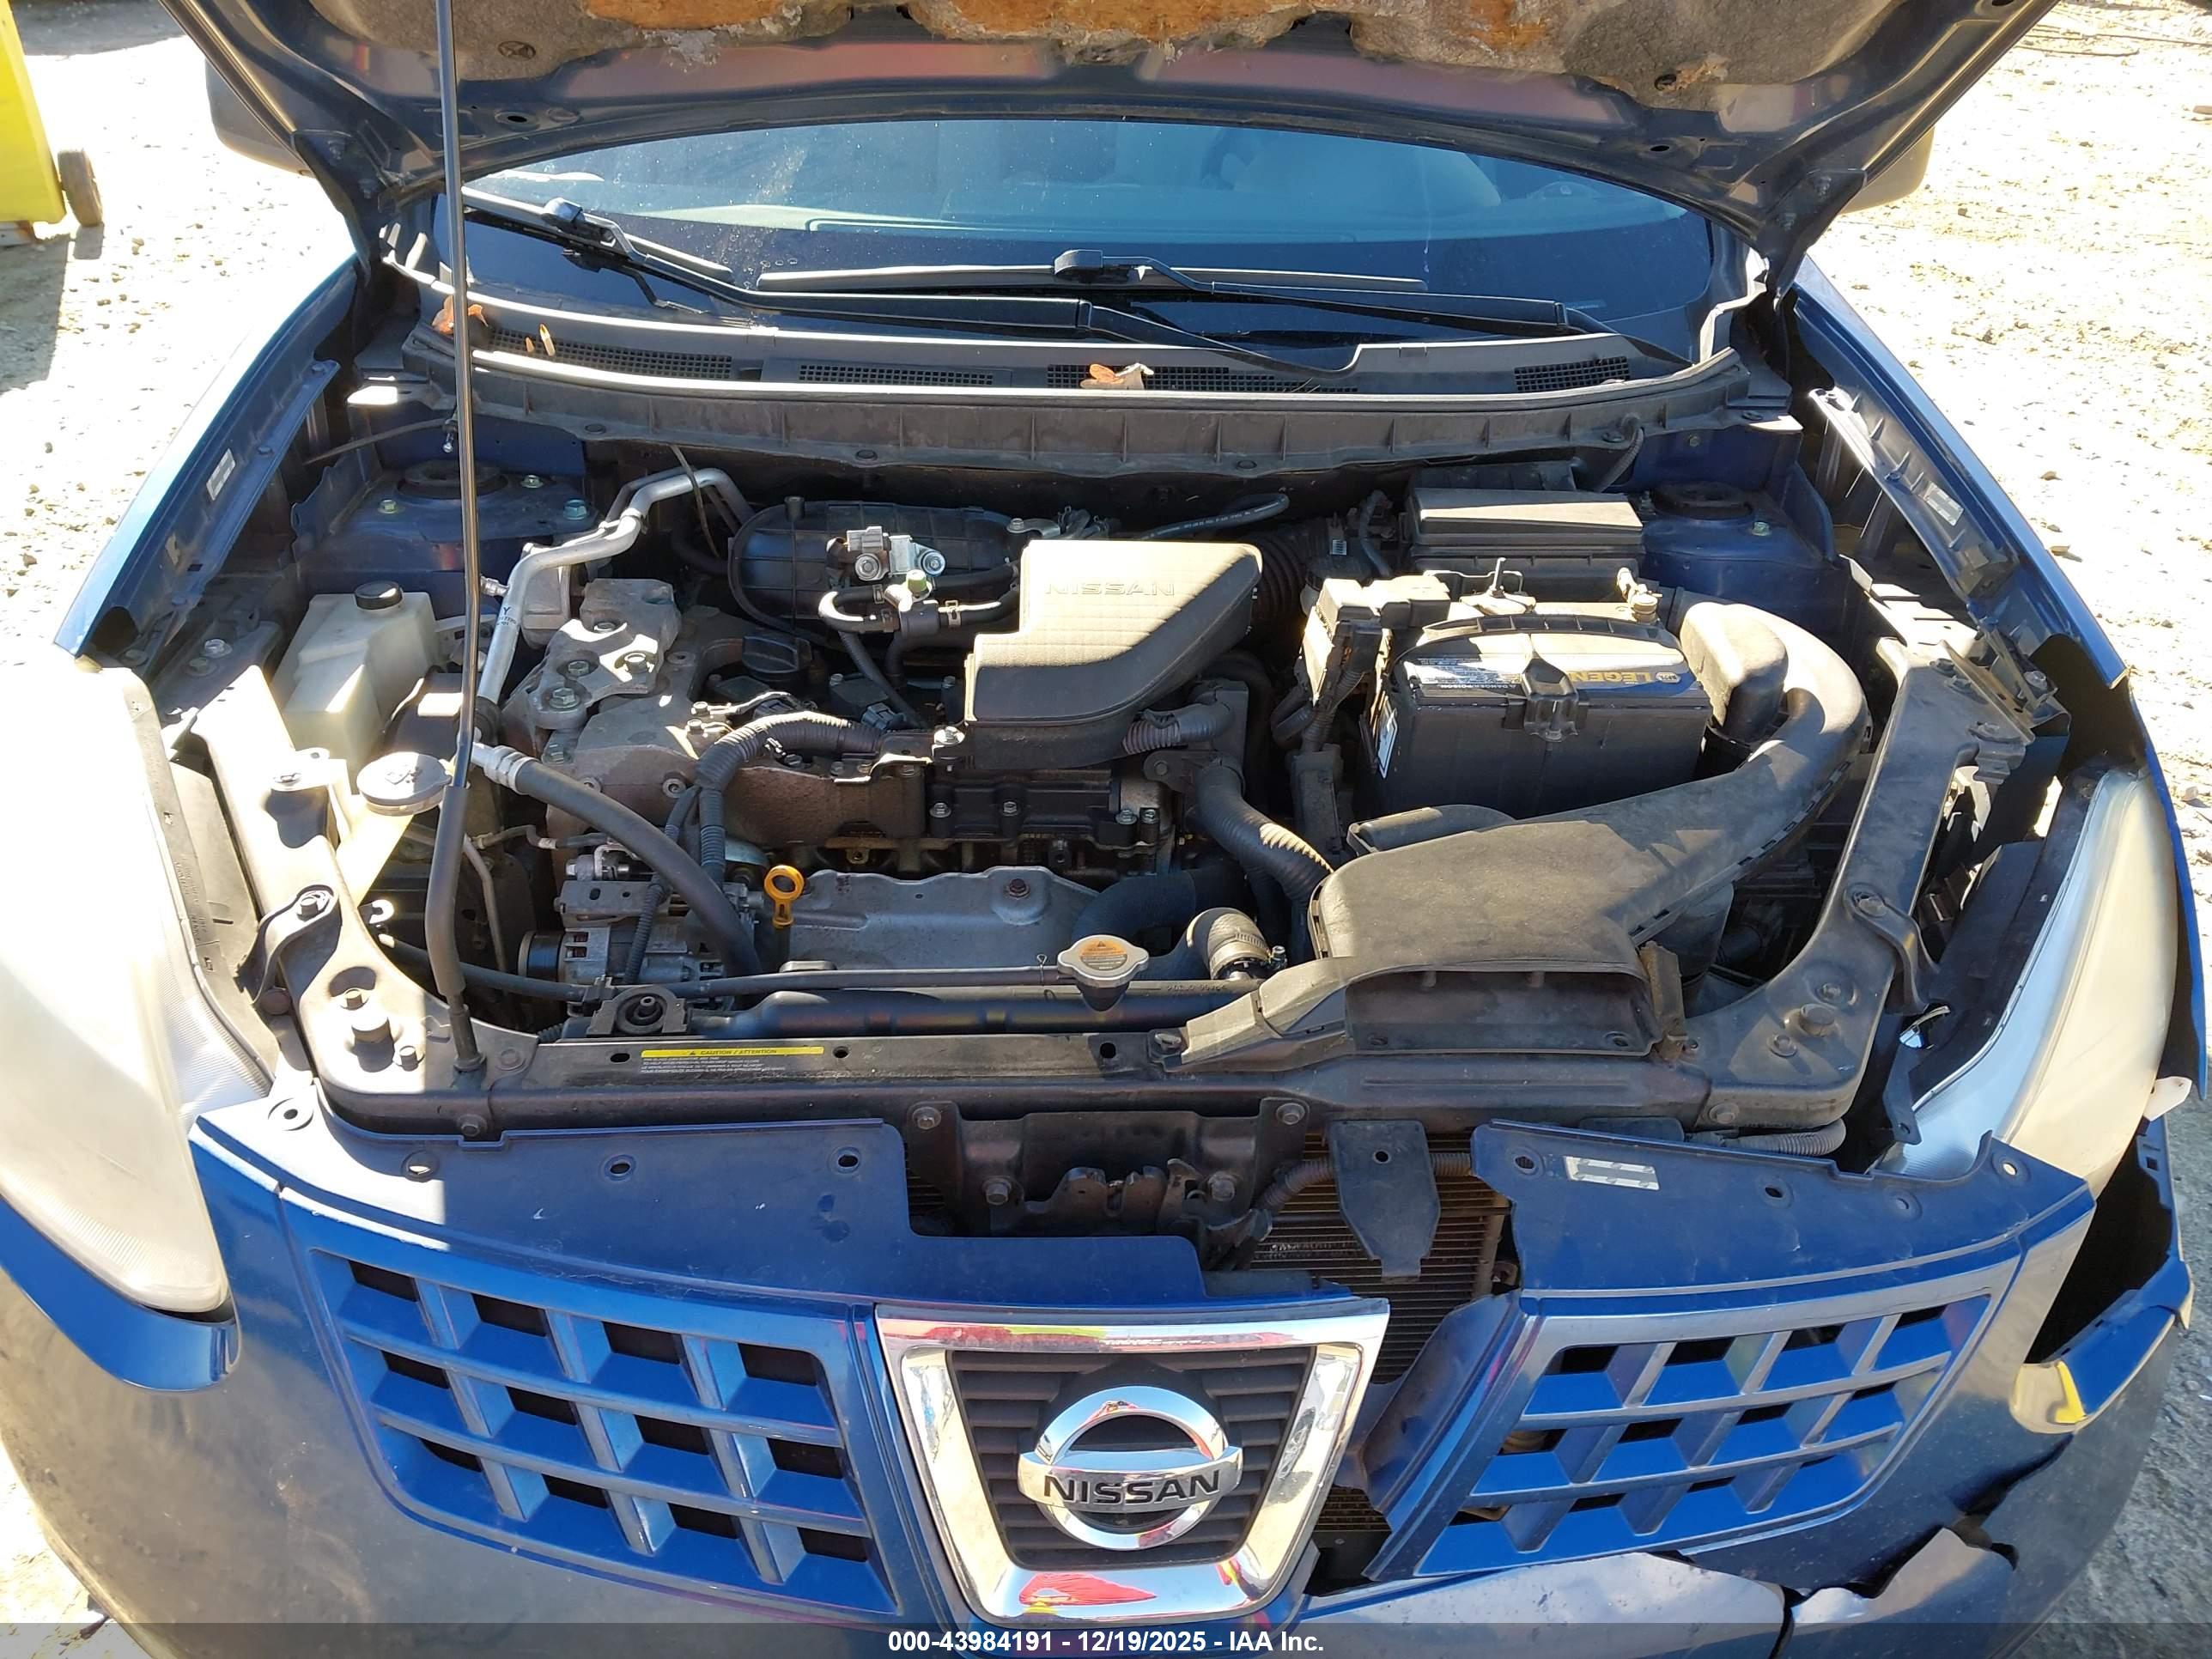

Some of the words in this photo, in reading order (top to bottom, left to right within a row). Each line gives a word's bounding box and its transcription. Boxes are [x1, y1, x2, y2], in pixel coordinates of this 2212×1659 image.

[1045, 582, 1175, 596] NISSAN
[1568, 672, 1653, 683] LEGEN
[1043, 1469, 1220, 1505] NISSAN
